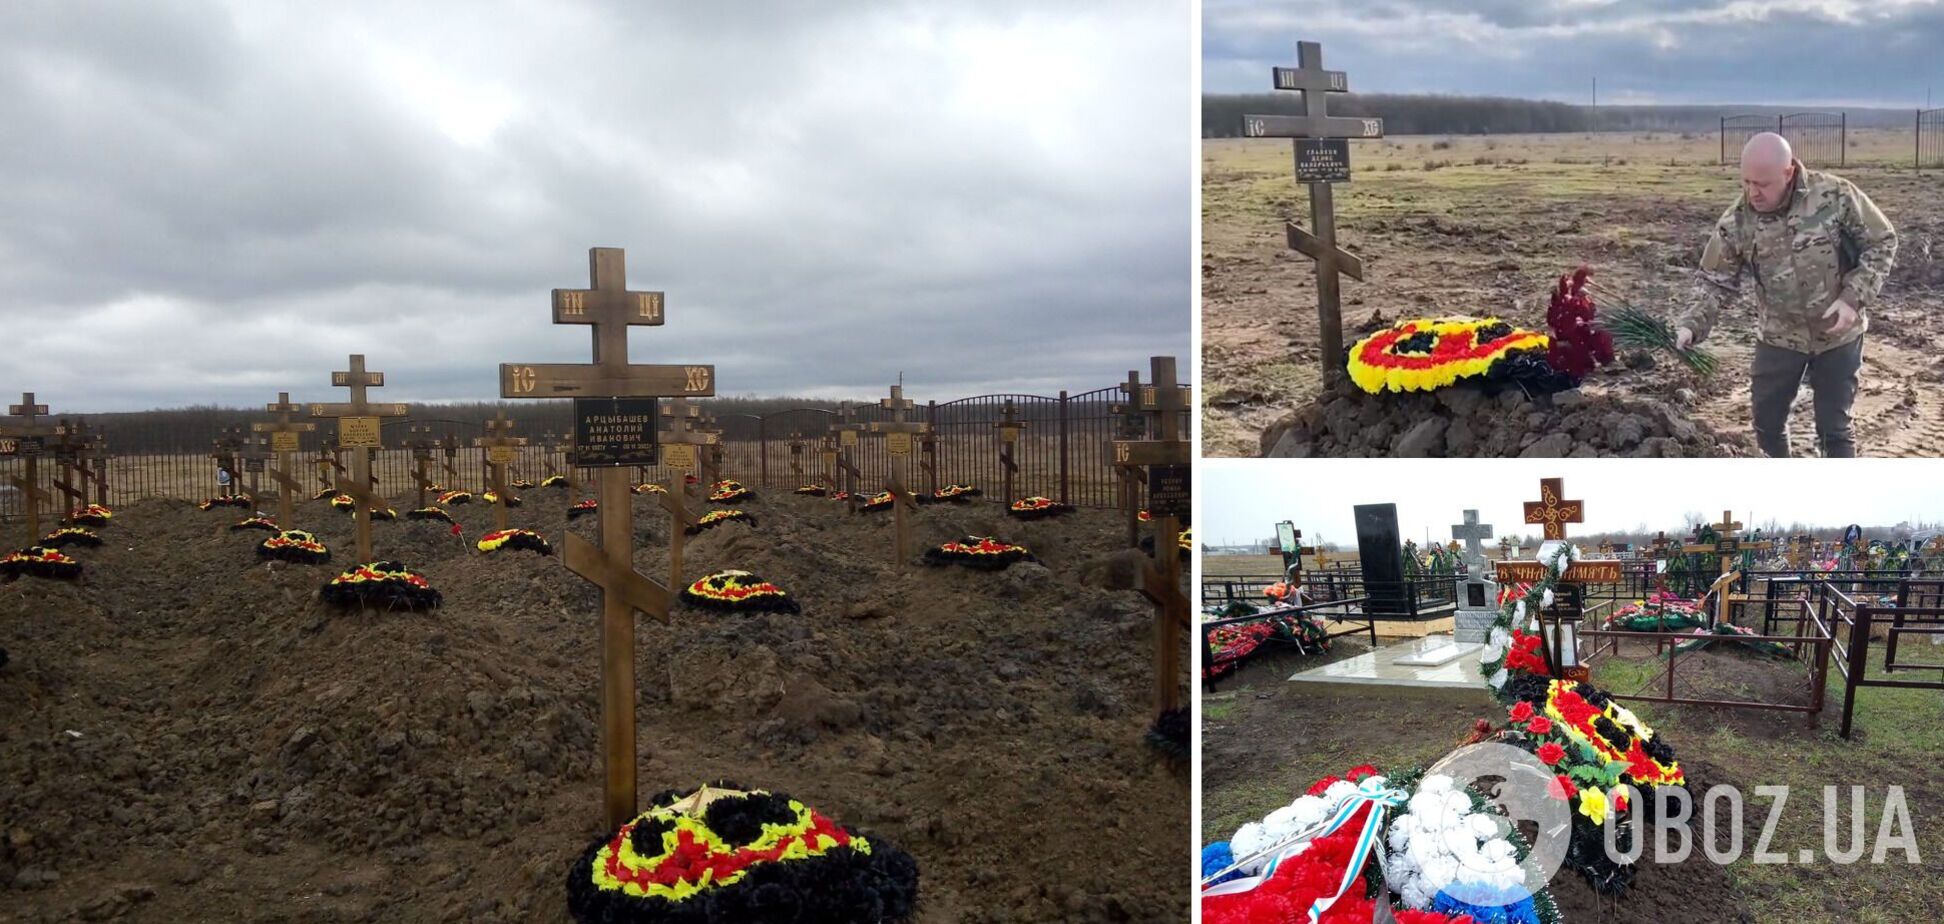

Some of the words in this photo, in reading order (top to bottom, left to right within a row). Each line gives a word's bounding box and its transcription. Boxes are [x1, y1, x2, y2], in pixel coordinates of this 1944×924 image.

[585, 415, 649, 424] АРЦЫБАШЕВ
[589, 424, 643, 433] АНАТОЛИЙ
[590, 434, 641, 443] ИВАНОВИЧ
